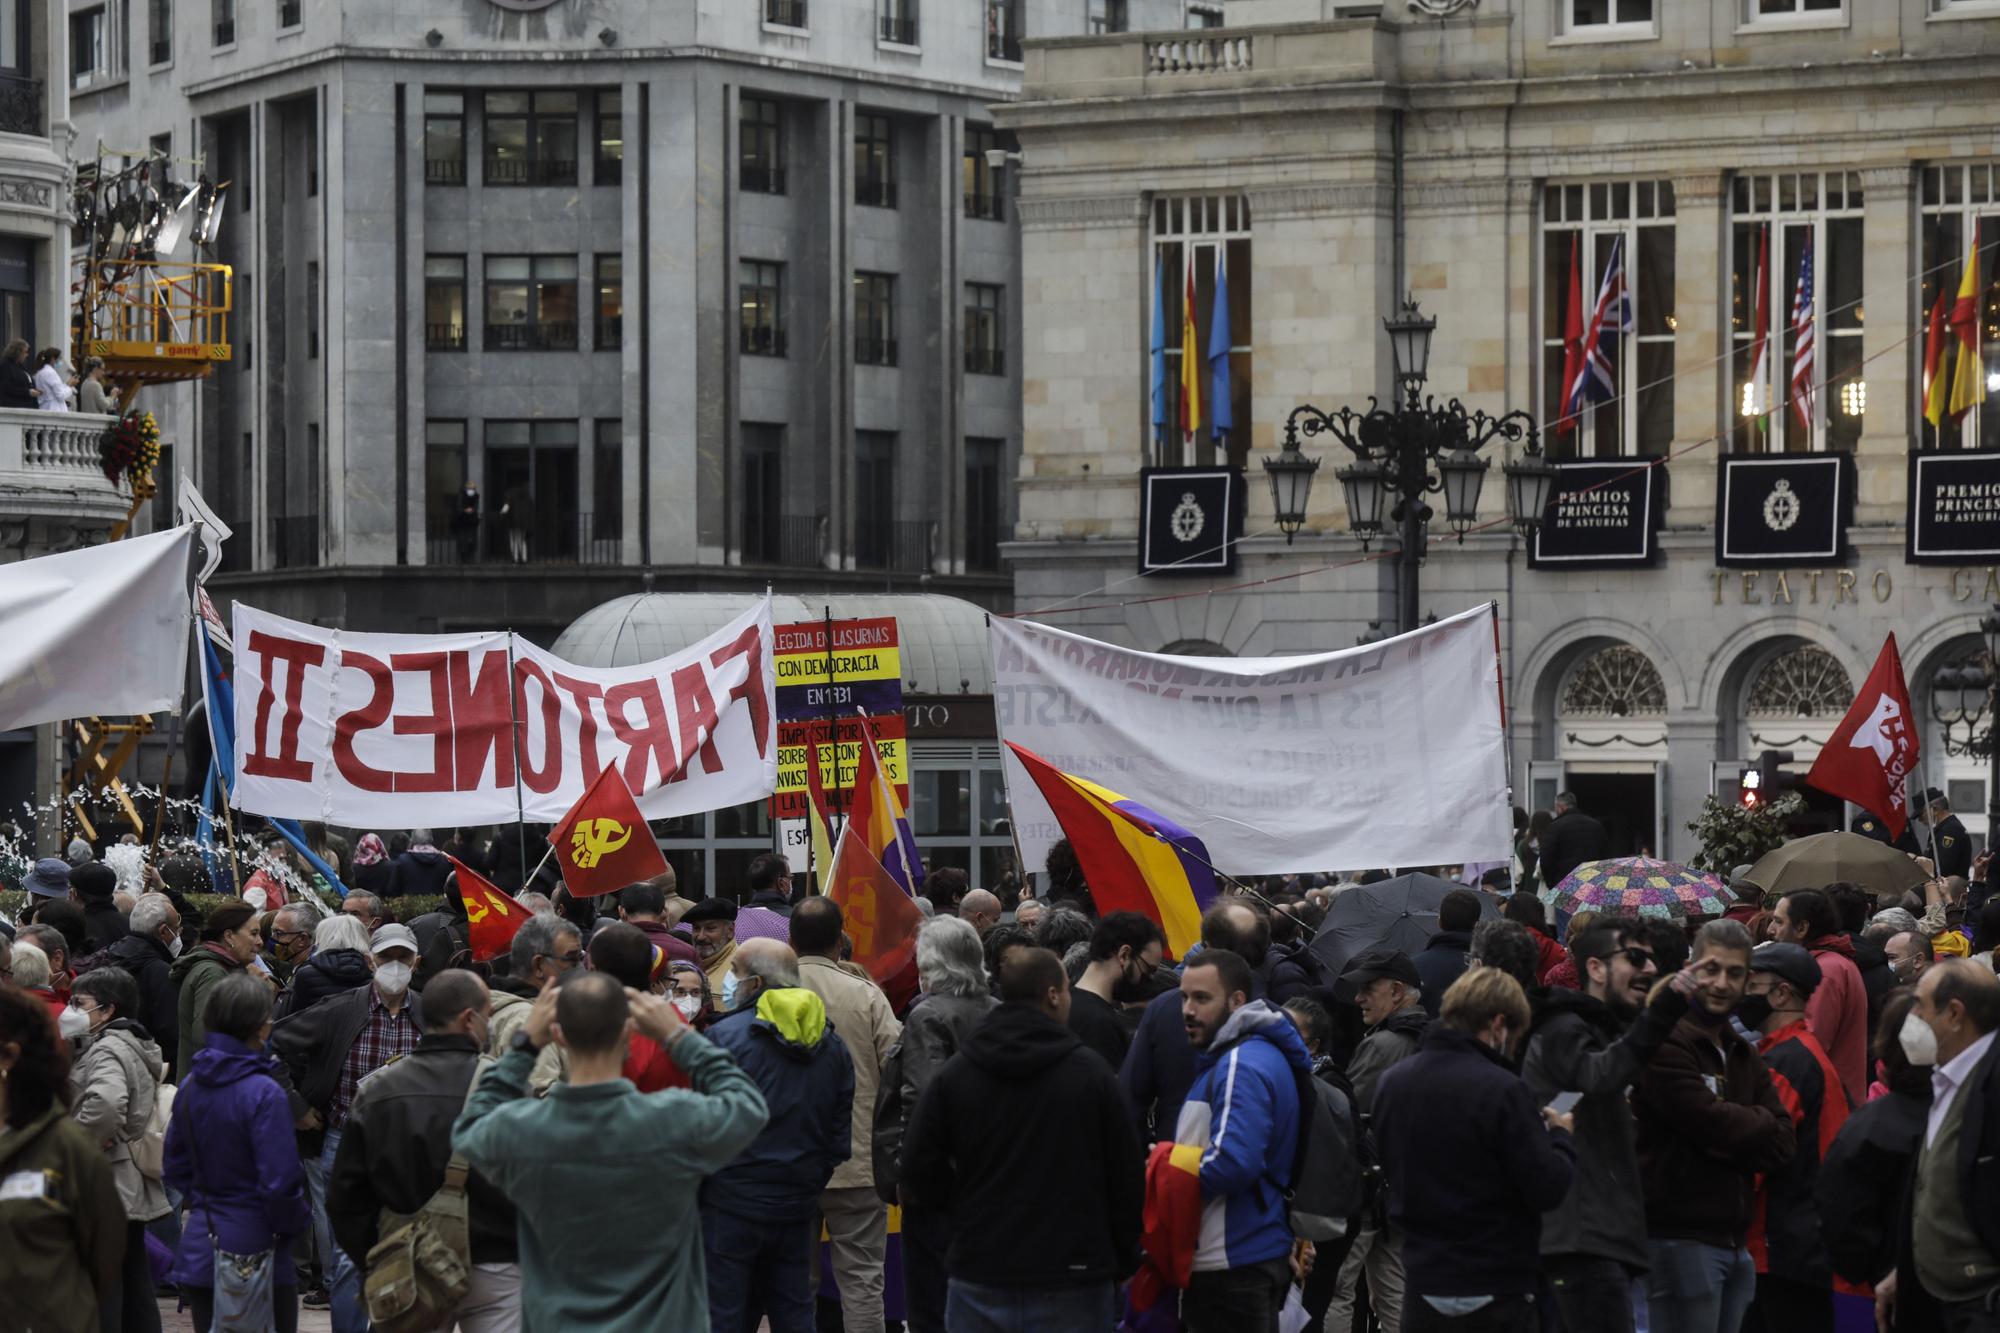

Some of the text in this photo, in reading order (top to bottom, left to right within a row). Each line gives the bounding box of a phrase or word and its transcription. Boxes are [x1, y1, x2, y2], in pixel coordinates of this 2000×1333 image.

[1559, 489, 1630, 504] PREMIOS
[1558, 504, 1629, 517] PRINCESA
[1935, 511, 2000, 523] DE ASTURI
[1557, 517, 1629, 528] DE ASTURIAS
[1709, 568, 1892, 605] TEATRO
[778, 654, 880, 677] CON DEMOCRACIA
[807, 688, 824, 705] EN
[836, 743, 856, 761] CON
[782, 794, 796, 811] LA
